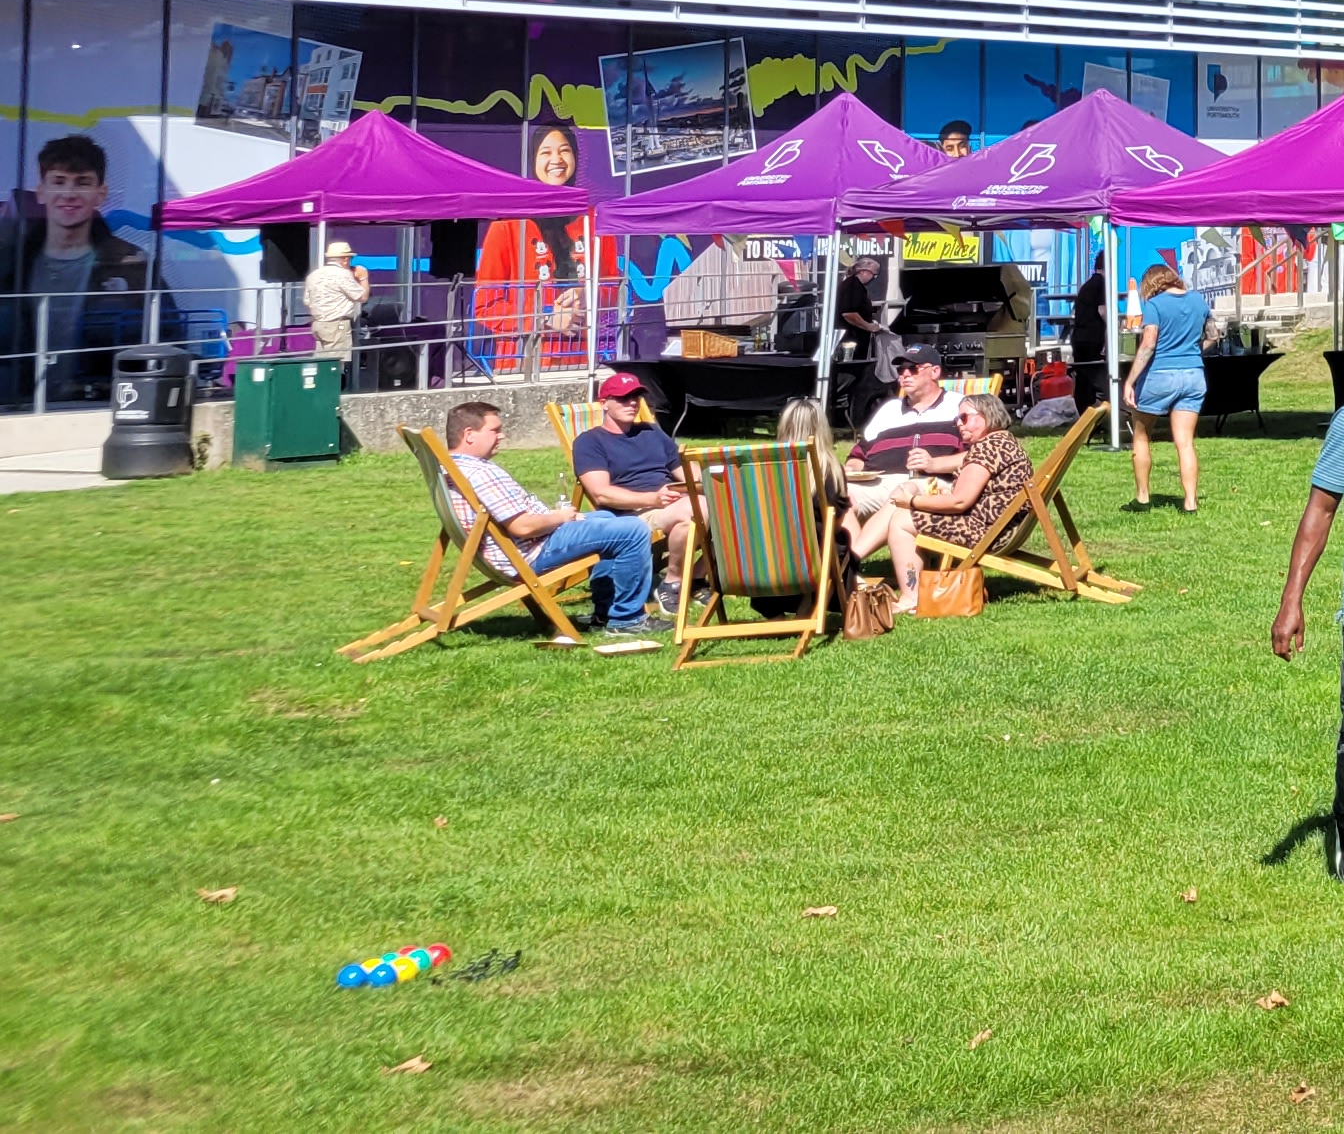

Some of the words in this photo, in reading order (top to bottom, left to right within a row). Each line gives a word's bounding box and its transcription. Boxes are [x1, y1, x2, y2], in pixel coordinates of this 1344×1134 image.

[746, 240, 760, 258] TO
[763, 240, 811, 258] BECM
[817, 237, 893, 256] INENDENT.
[1017, 264, 1045, 282] NITY.
